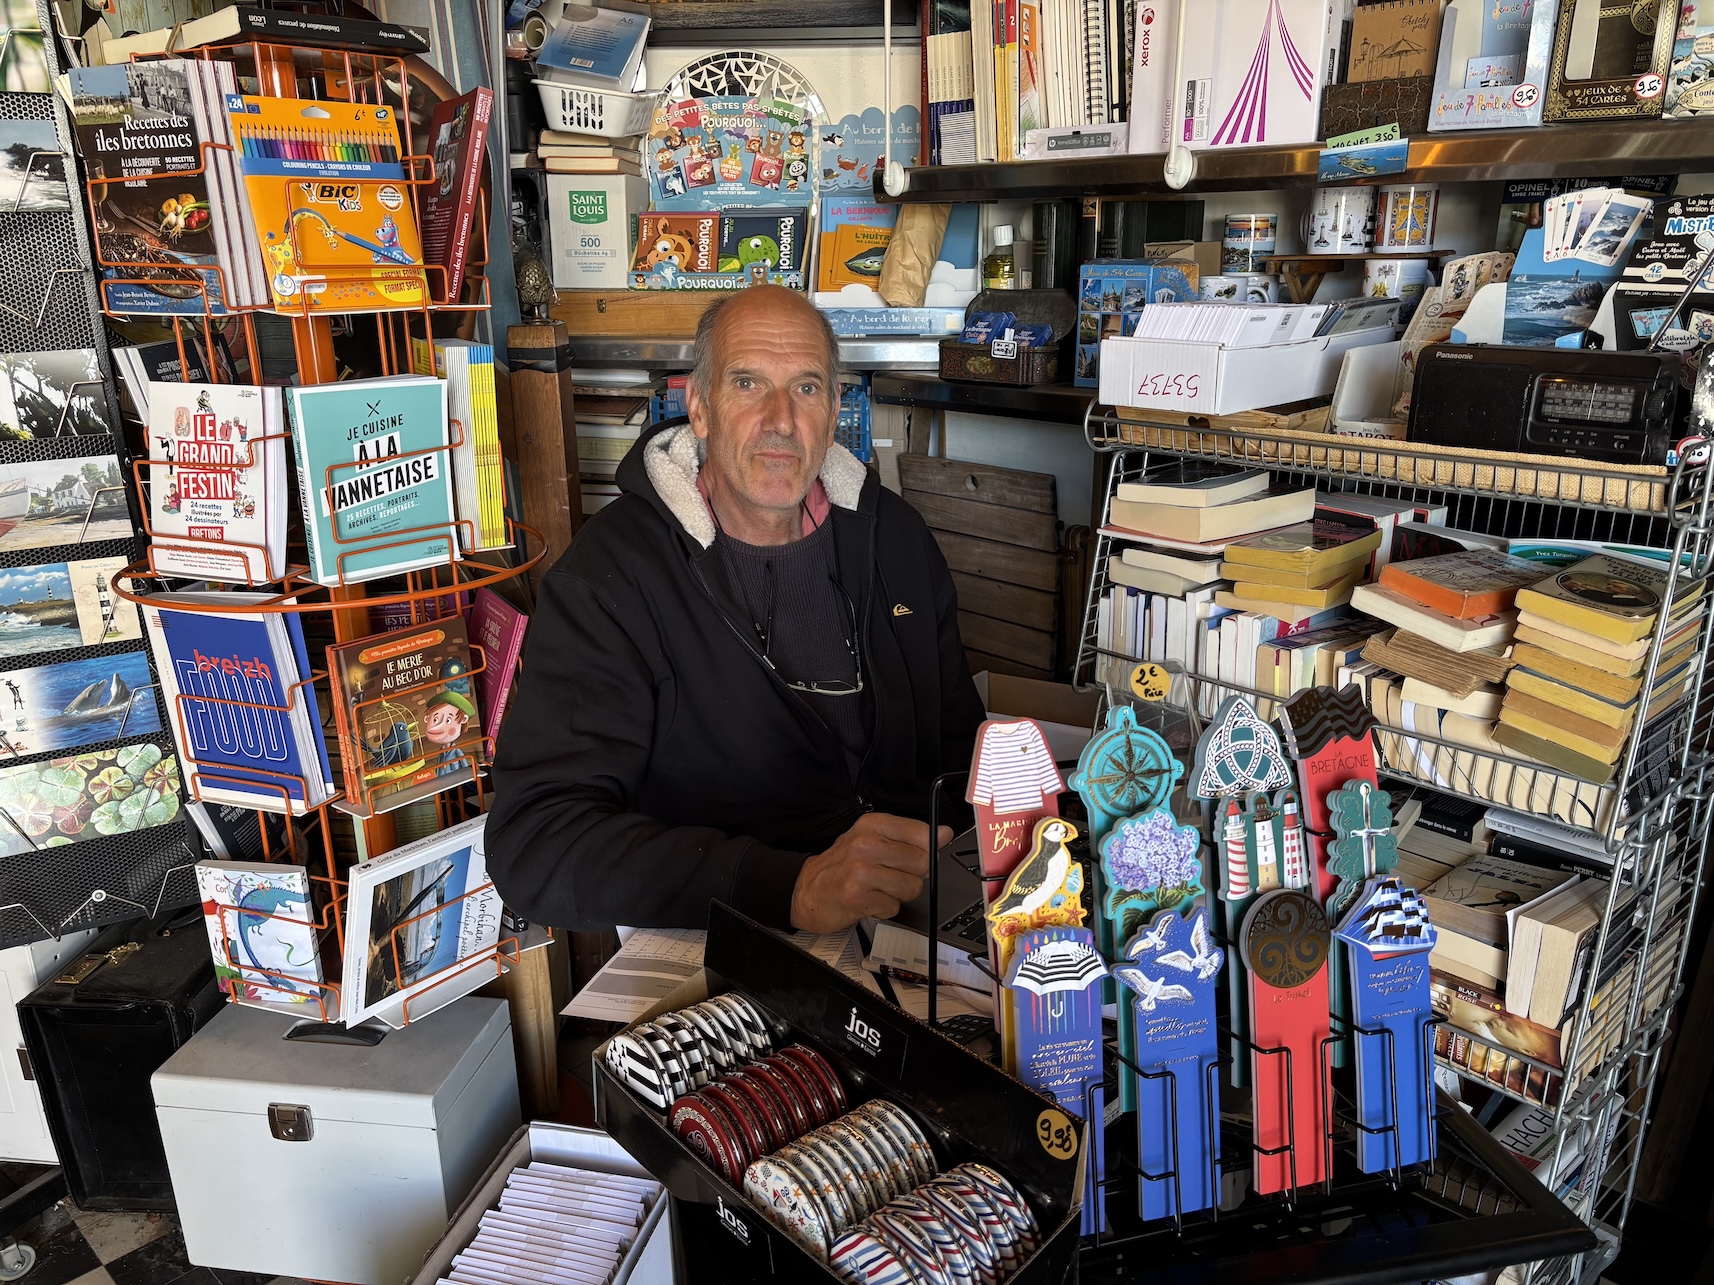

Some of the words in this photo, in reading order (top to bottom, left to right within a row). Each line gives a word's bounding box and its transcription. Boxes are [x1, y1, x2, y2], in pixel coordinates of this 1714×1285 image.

[1400, 12, 1429, 28] Sketch
[1412, 18, 1430, 32] pad
[1141, 28, 1150, 66] xerox
[1436, 94, 1452, 116] jeu
[1454, 102, 1464, 110] de
[1465, 94, 1474, 116] 7
[1476, 93, 1512, 114] familles
[654, 114, 672, 125] DES
[674, 104, 710, 118] PETITES
[712, 100, 740, 110] BÊTES
[742, 102, 760, 111] PAS
[761, 105, 771, 114] SI
[772, 108, 800, 122] BÊTES
[124, 114, 168, 131] Recettes
[171, 111, 188, 128] des
[1162, 98, 1172, 144] Performer
[896, 122, 912, 134] de
[95, 128, 120, 152] îles
[120, 127, 192, 150] bretonnes
[282, 162, 307, 170] COLOURING
[308, 162, 324, 170] PENCILS
[1508, 182, 1550, 192] OPINEL
[1622, 176, 1655, 185] OPINEL
[572, 194, 604, 204] SAINT
[574, 205, 604, 218] LOUIS
[831, 207, 842, 215] LA
[846, 206, 890, 215] BERNIQUE
[457, 212, 470, 247] bretonnes
[580, 238, 600, 248] 500
[453, 259, 462, 271] des
[1650, 264, 1662, 273] 42
[1110, 268, 1123, 276] 54
[384, 284, 405, 294] FORMAT
[448, 271, 460, 298] Recettes
[850, 314, 862, 322] Au
[864, 314, 886, 322] bord
[888, 314, 900, 322] de
[902, 314, 910, 322] la
[1435, 350, 1474, 360] Panasonic
[196, 416, 215, 440] LE
[346, 426, 358, 441] JE
[362, 414, 404, 436] CUISINE
[180, 442, 232, 470] GRAND
[358, 440, 370, 470] À
[375, 435, 398, 463] LA
[180, 473, 234, 498] FESTIN
[324, 456, 434, 511] VANNETAISE
[199, 502, 222, 510] recettes
[194, 516, 228, 524] dessinateurs
[346, 513, 354, 522] 25
[191, 528, 222, 540] BRETONS
[193, 649, 272, 682] breizh
[386, 660, 396, 674] LE
[397, 653, 424, 671] MERLE
[382, 678, 394, 690] AU
[396, 672, 412, 686] BEC
[414, 666, 434, 680] D'OR
[176, 660, 288, 761] FOOD
[1334, 750, 1342, 758] LA
[1311, 753, 1370, 776] BRETAGNE
[988, 822, 1000, 831] LA
[376, 854, 392, 864] Golfe
[1573, 864, 1596, 876] PERRY
[1458, 986, 1479, 998] BLACK
[1456, 994, 1477, 1004] ROSE
[844, 1006, 881, 1047] jos
[716, 1196, 748, 1238] jos
